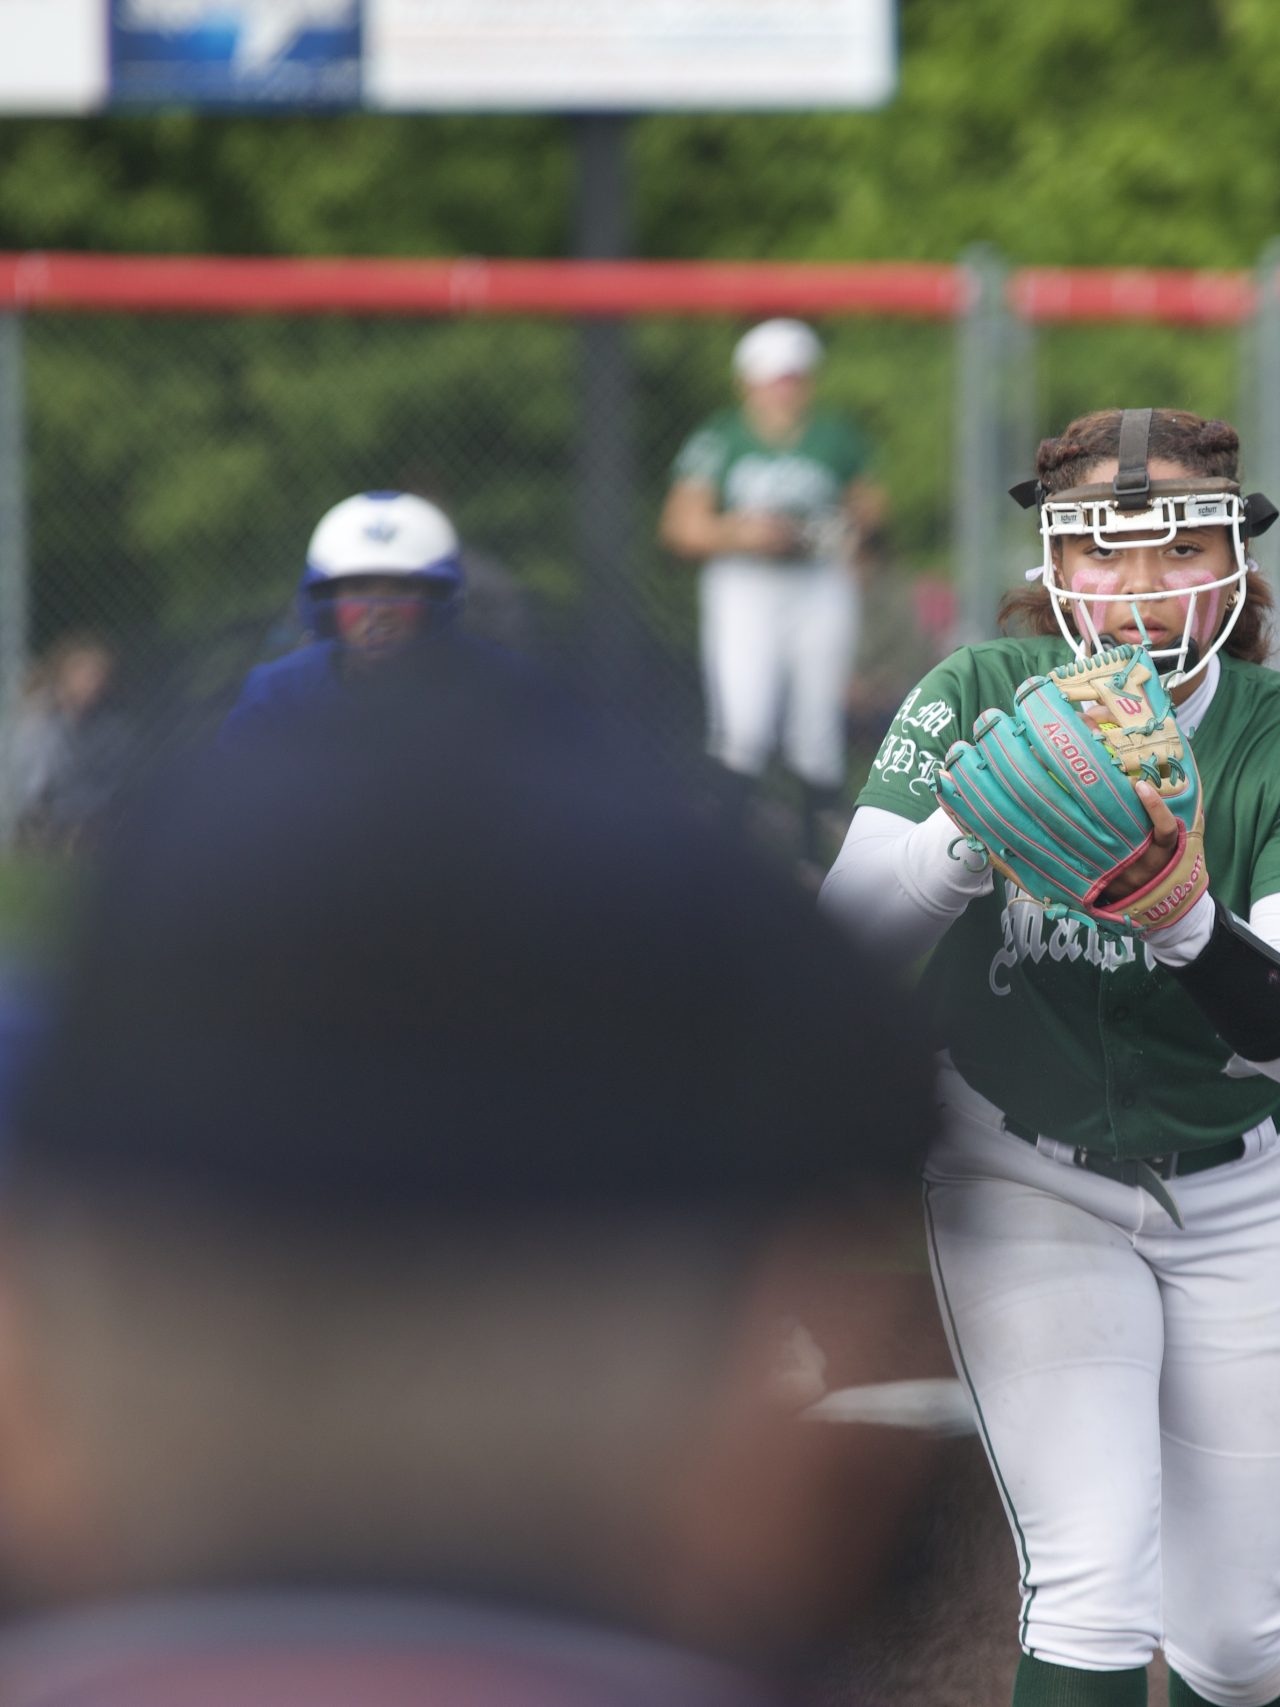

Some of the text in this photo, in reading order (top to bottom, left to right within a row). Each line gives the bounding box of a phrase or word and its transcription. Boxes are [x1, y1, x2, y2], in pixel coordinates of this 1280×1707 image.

[1198, 506, 1217, 515] schutt
[896, 687, 955, 737] AM
[1043, 721, 1099, 786] A2000
[1142, 853, 1202, 922] Wilson
